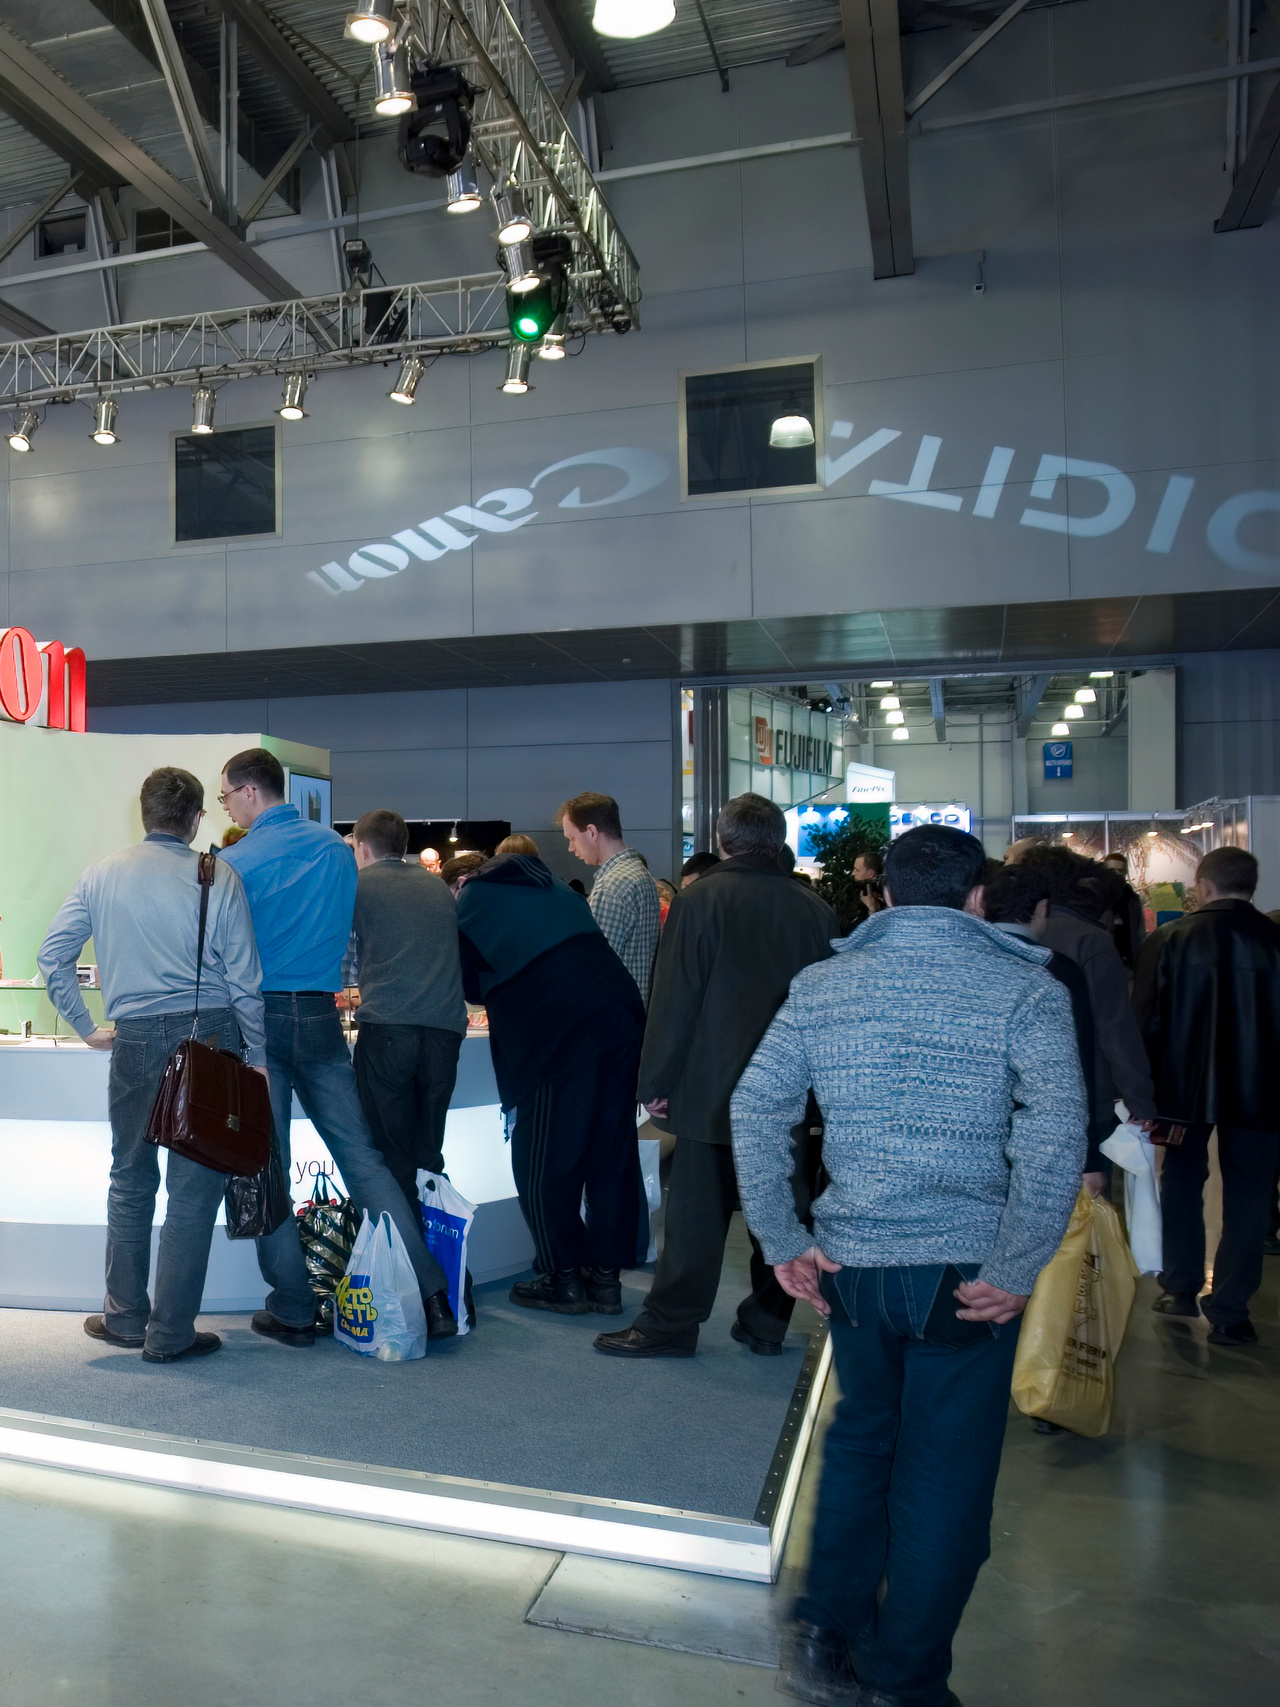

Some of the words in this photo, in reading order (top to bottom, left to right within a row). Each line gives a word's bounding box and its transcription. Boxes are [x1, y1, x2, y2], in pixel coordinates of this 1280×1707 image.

[306, 446, 673, 597] Canon
[775, 729, 833, 775] FUJIFILM
[295, 1160, 335, 1184] you
